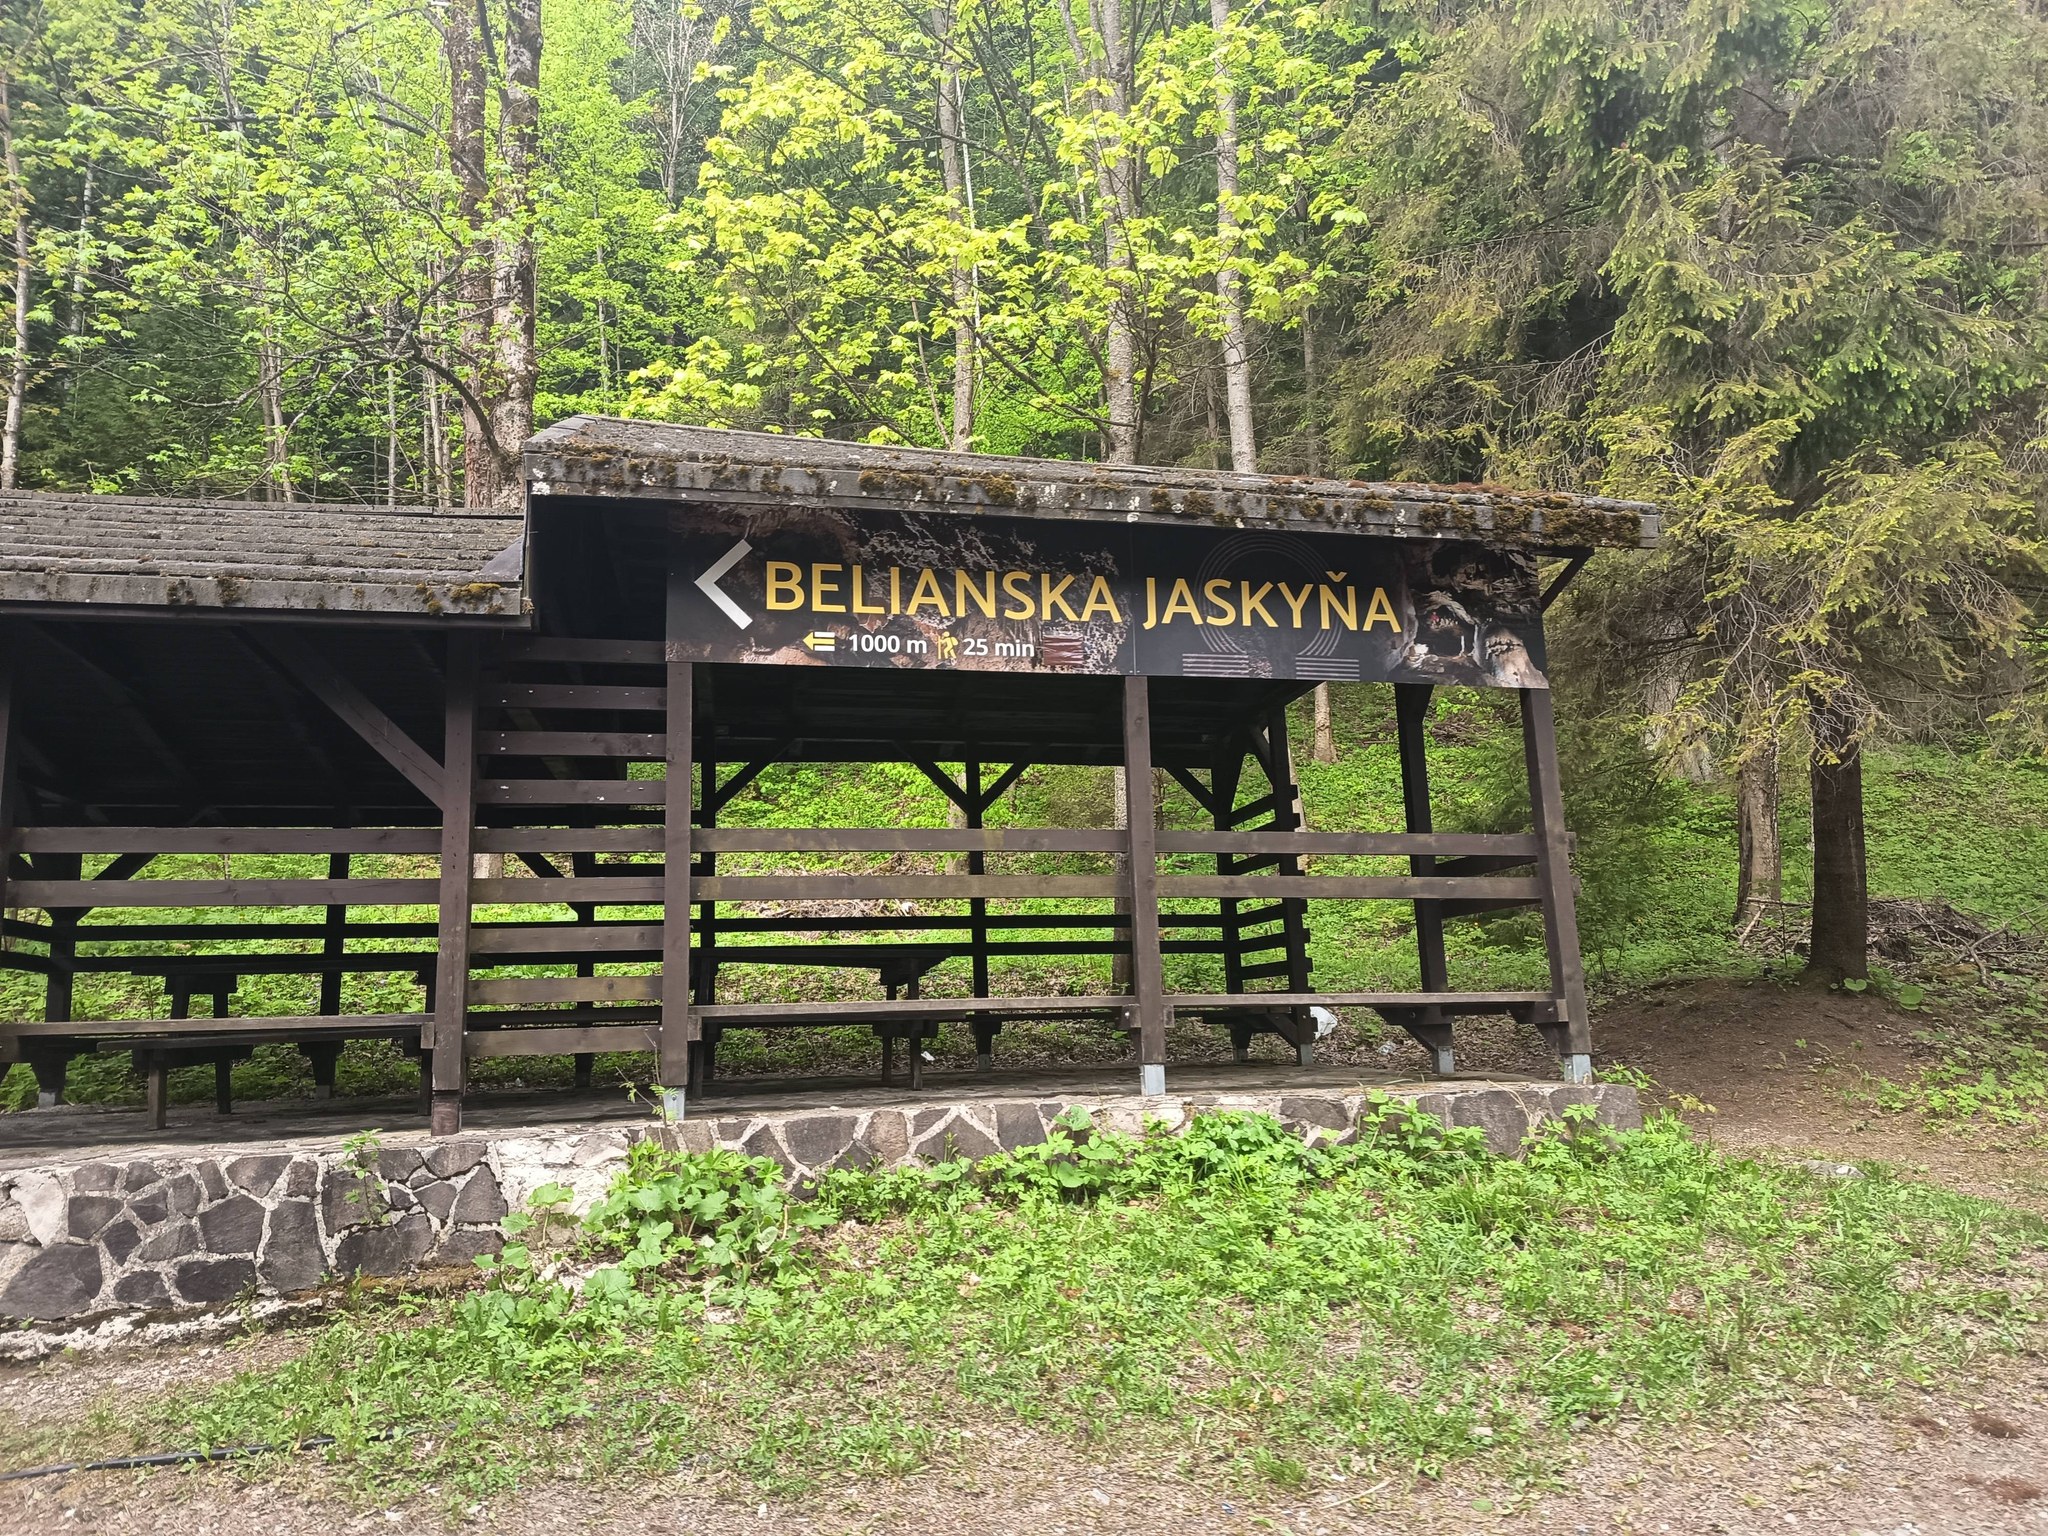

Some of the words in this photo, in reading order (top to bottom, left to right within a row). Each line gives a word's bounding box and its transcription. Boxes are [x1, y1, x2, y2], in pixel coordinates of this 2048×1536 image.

[765, 561, 1122, 623] BELIANSKA
[1142, 571, 1402, 633] JASKYŇA
[849, 634, 900, 654] 1000
[906, 638, 928, 655] m
[963, 637, 989, 656] 25
[994, 639, 1035, 658] min
